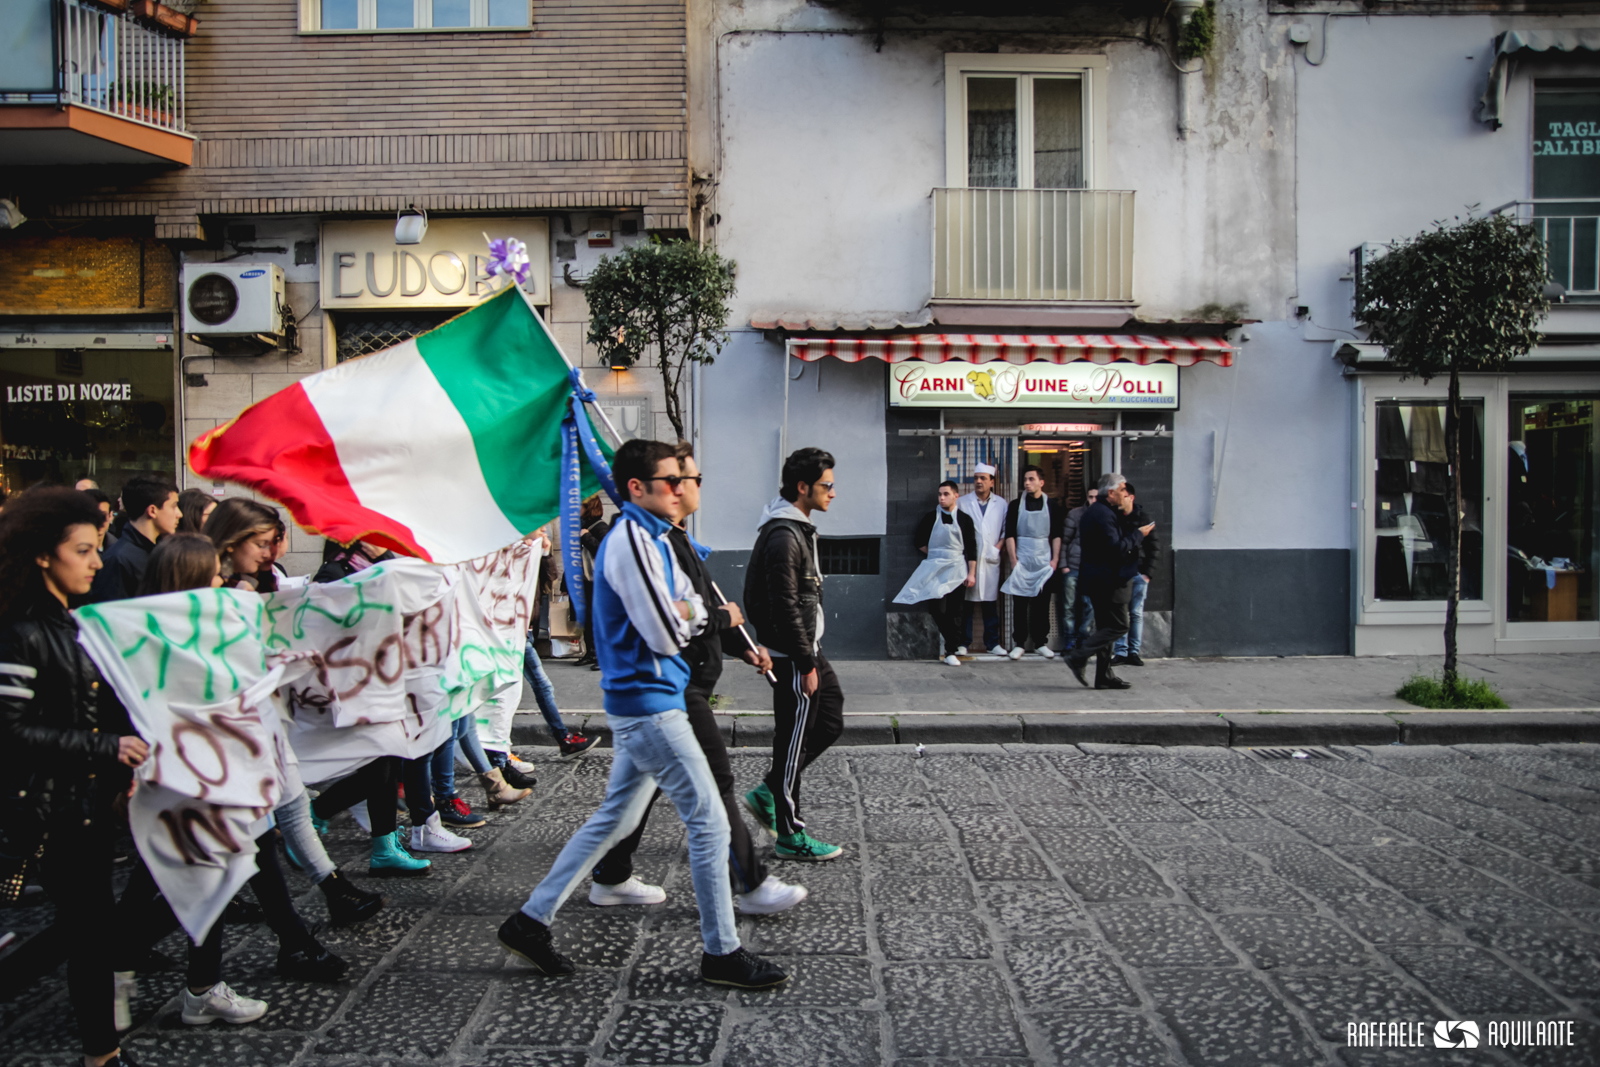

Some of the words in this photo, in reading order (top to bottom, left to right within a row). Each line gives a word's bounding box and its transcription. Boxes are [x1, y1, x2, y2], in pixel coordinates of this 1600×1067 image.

[7, 384, 53, 403] LISTE
[57, 383, 76, 402] DI
[79, 383, 132, 401] NOZZE
[893, 365, 965, 402] CARNI
[994, 365, 1068, 404] SUINE
[1089, 366, 1163, 404] POLLI
